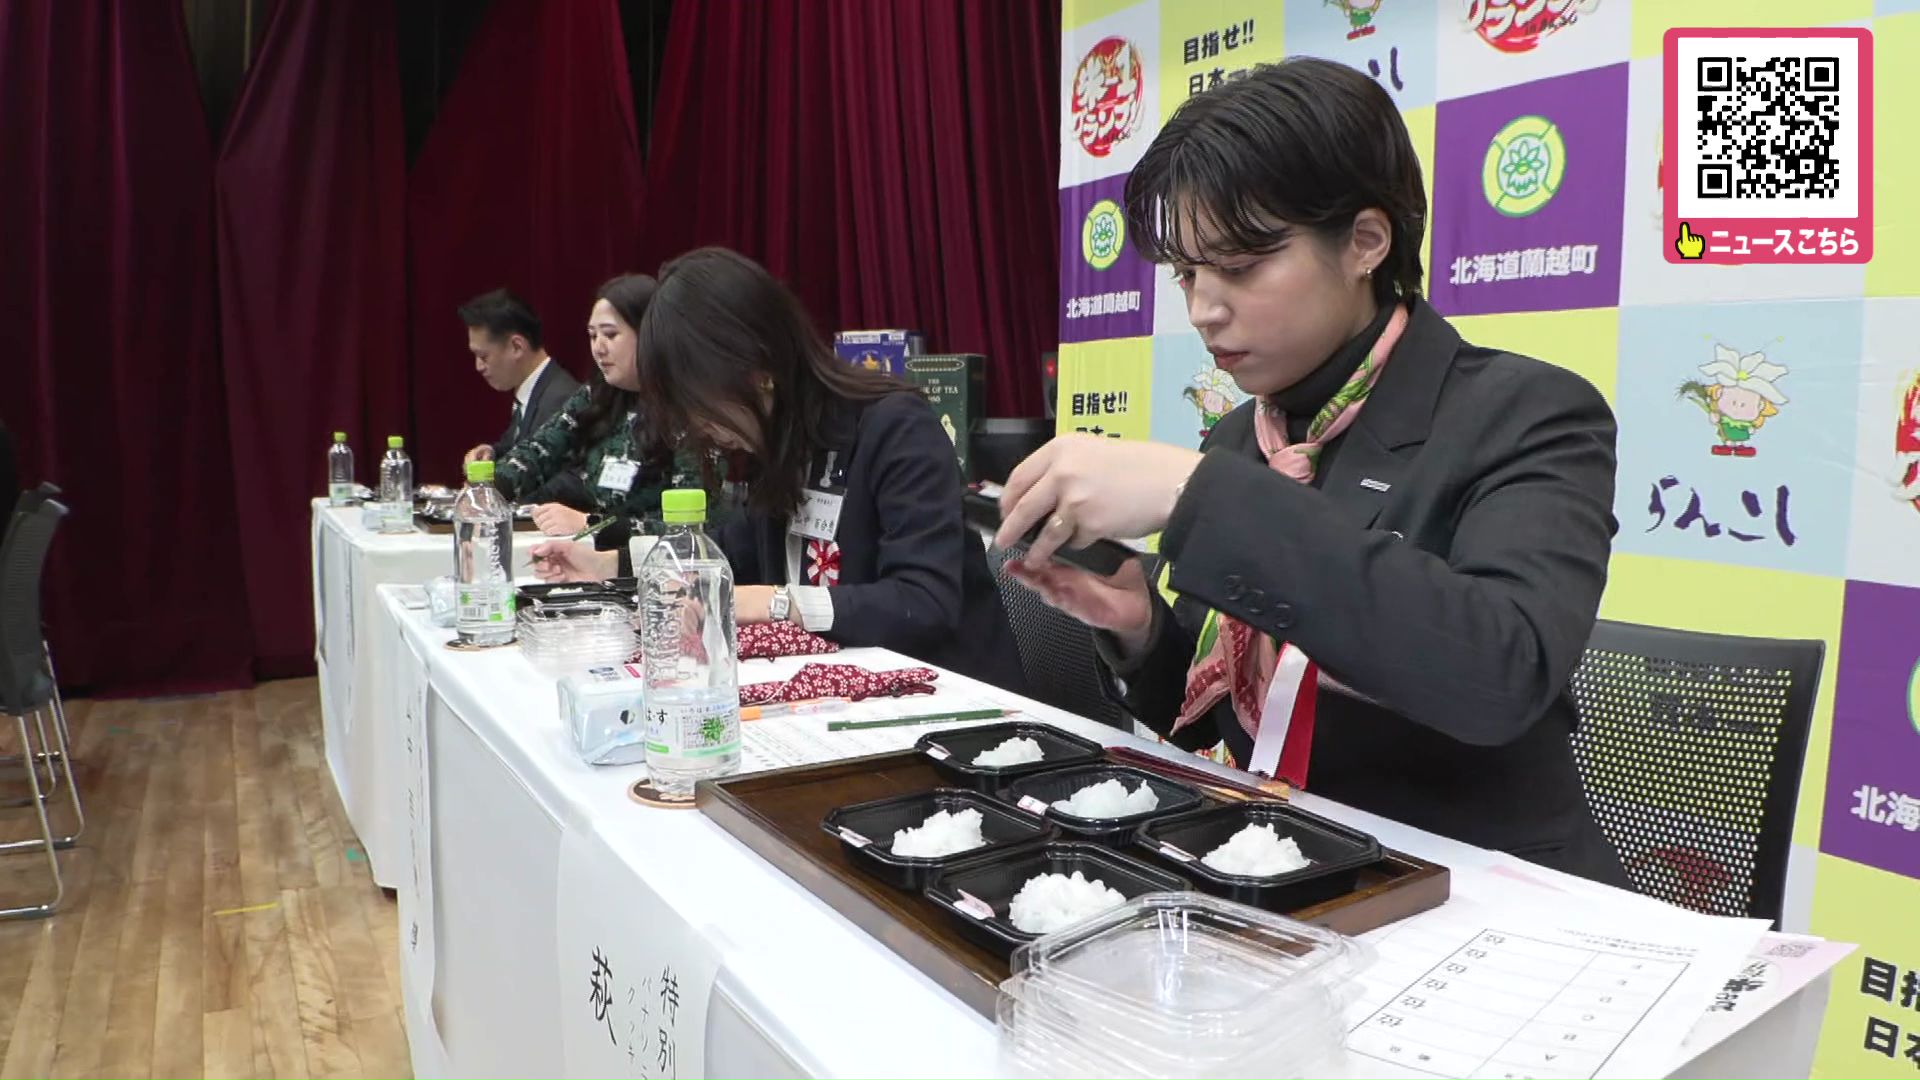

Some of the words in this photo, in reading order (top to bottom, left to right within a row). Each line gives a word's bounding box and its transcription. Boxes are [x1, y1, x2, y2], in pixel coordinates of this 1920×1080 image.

[1450, 245, 1598, 285] 北海道蘭越町
[1072, 391, 1127, 415] 目指せ!!
[1645, 474, 1798, 546] らんこし
[656, 964, 680, 1080] 特別
